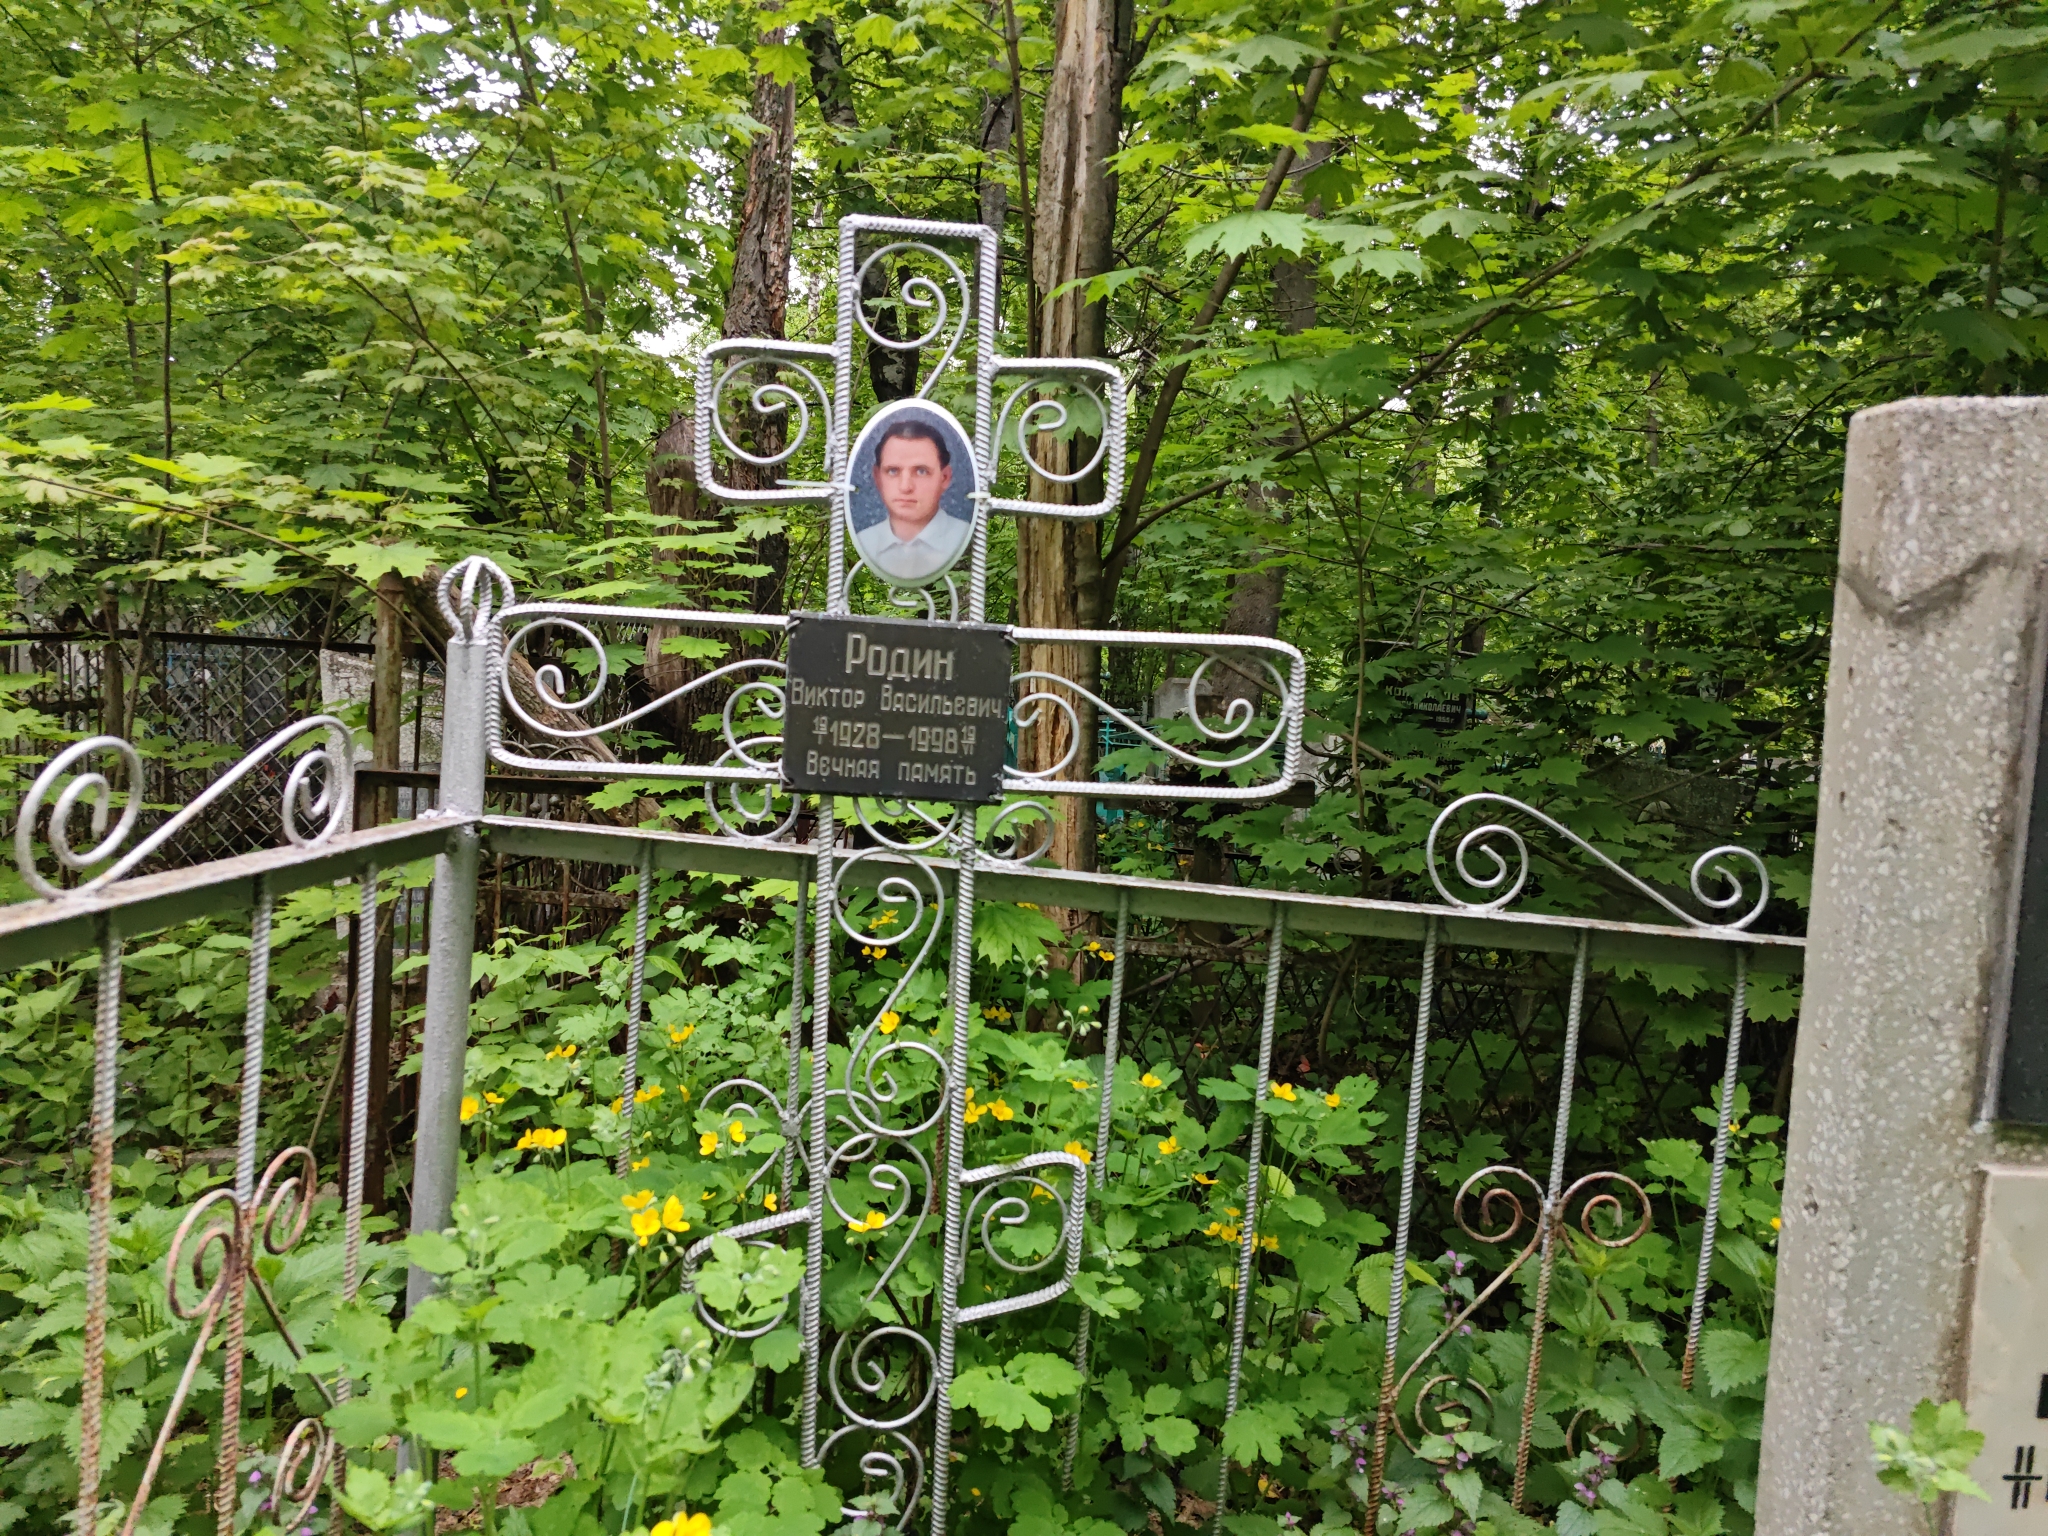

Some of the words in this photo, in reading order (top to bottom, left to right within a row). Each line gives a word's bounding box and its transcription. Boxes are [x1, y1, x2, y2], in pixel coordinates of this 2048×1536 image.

[845, 632, 955, 681] Родин
[790, 678, 866, 708] Виктор
[805, 749, 881, 780] Вечная
[897, 760, 977, 786] память
